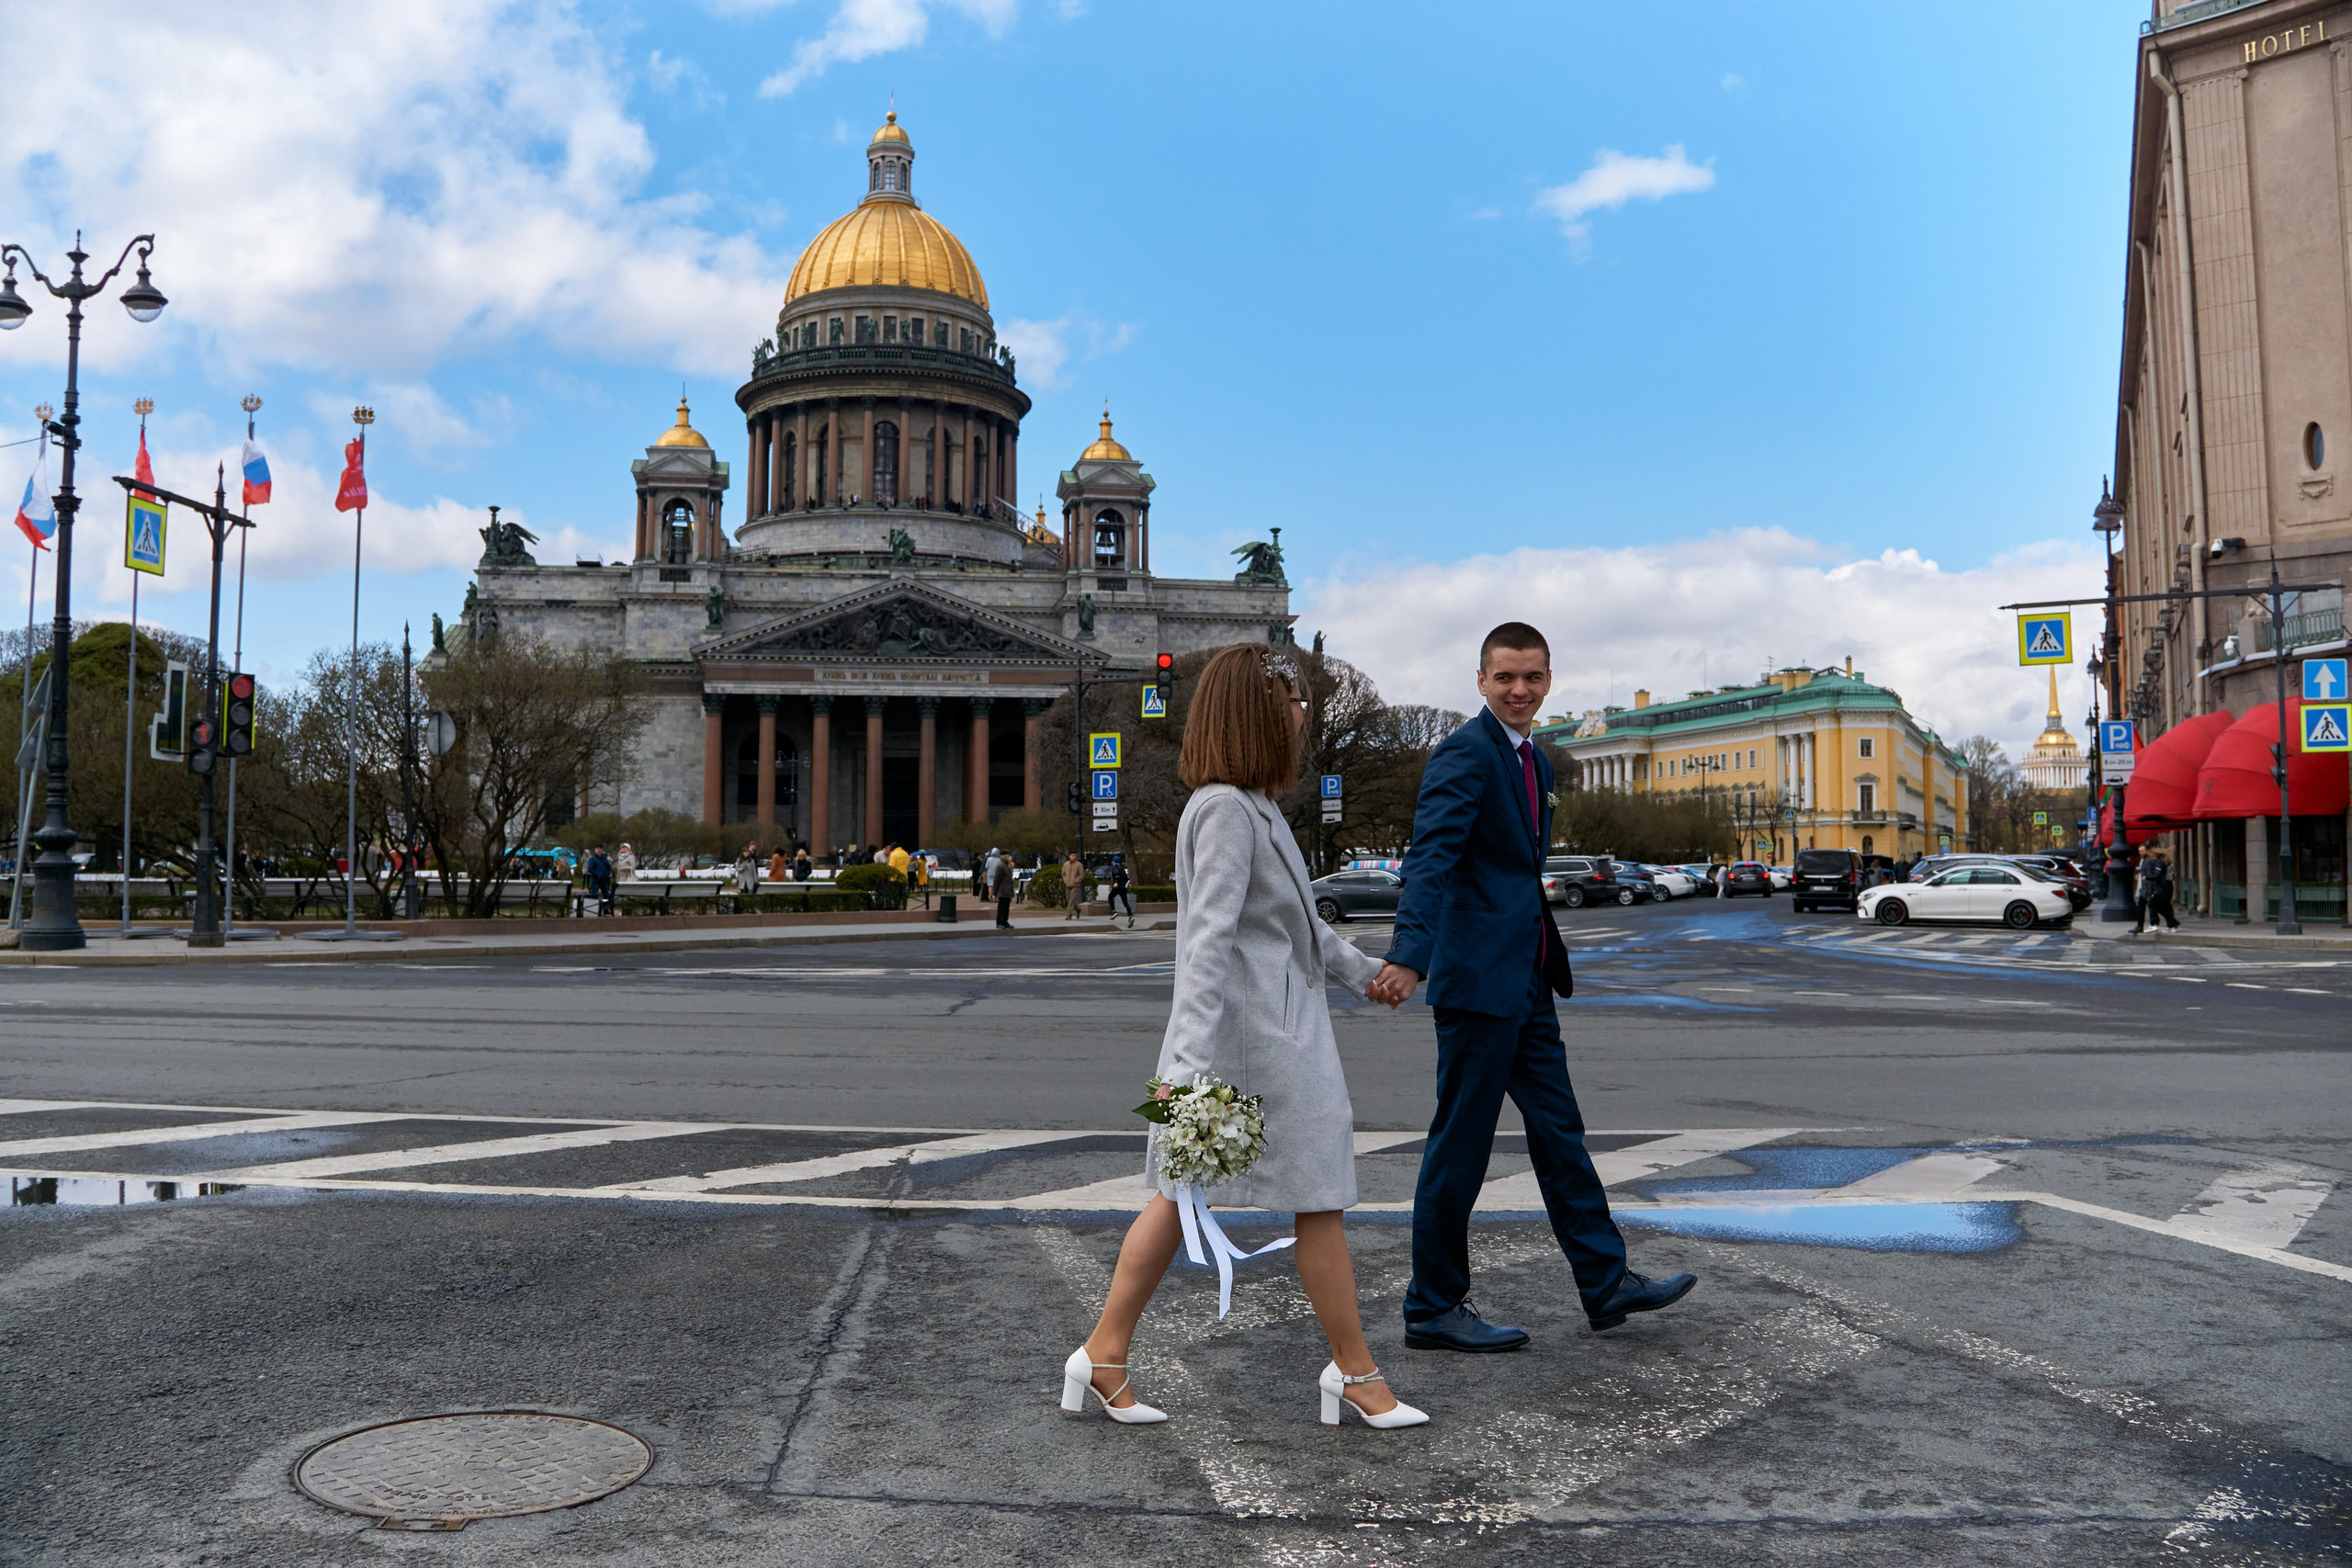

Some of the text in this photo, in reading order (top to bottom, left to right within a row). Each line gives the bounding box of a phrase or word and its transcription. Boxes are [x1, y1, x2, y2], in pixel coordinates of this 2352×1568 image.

[2244, 20, 2331, 62] HOTEL
[2109, 725, 2127, 750] P
[1100, 774, 1113, 795] P
[1327, 778, 1338, 795] P
